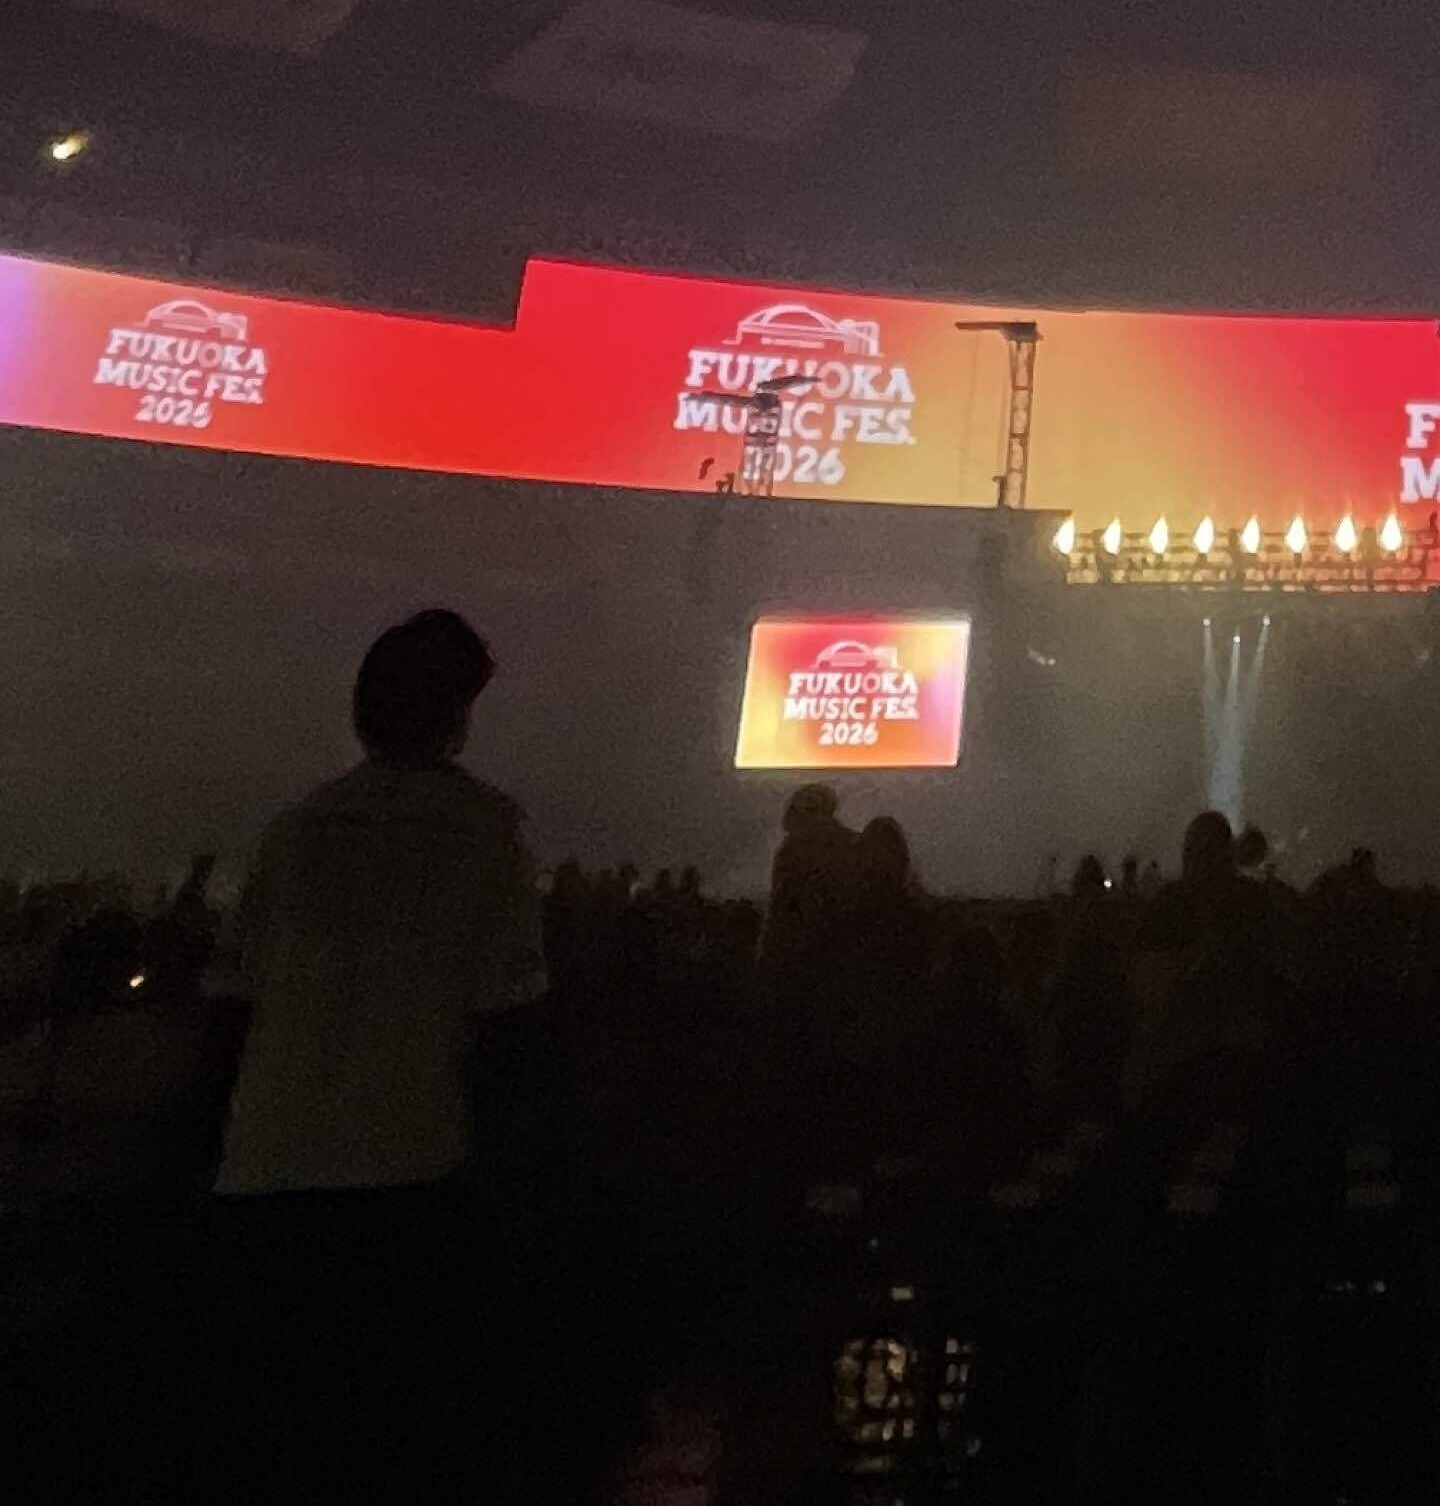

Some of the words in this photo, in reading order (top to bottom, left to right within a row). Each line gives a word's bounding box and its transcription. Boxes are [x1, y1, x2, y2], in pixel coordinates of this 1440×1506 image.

[106, 327, 267, 374] FUKUOKA
[93, 358, 202, 395] MUSIC
[135, 394, 212, 428] 2026
[673, 392, 824, 440] MUIC
[831, 406, 916, 445] FES.
[788, 672, 918, 695] FUKUOKA
[783, 697, 866, 720] MUSIC
[819, 723, 879, 744] 2026
